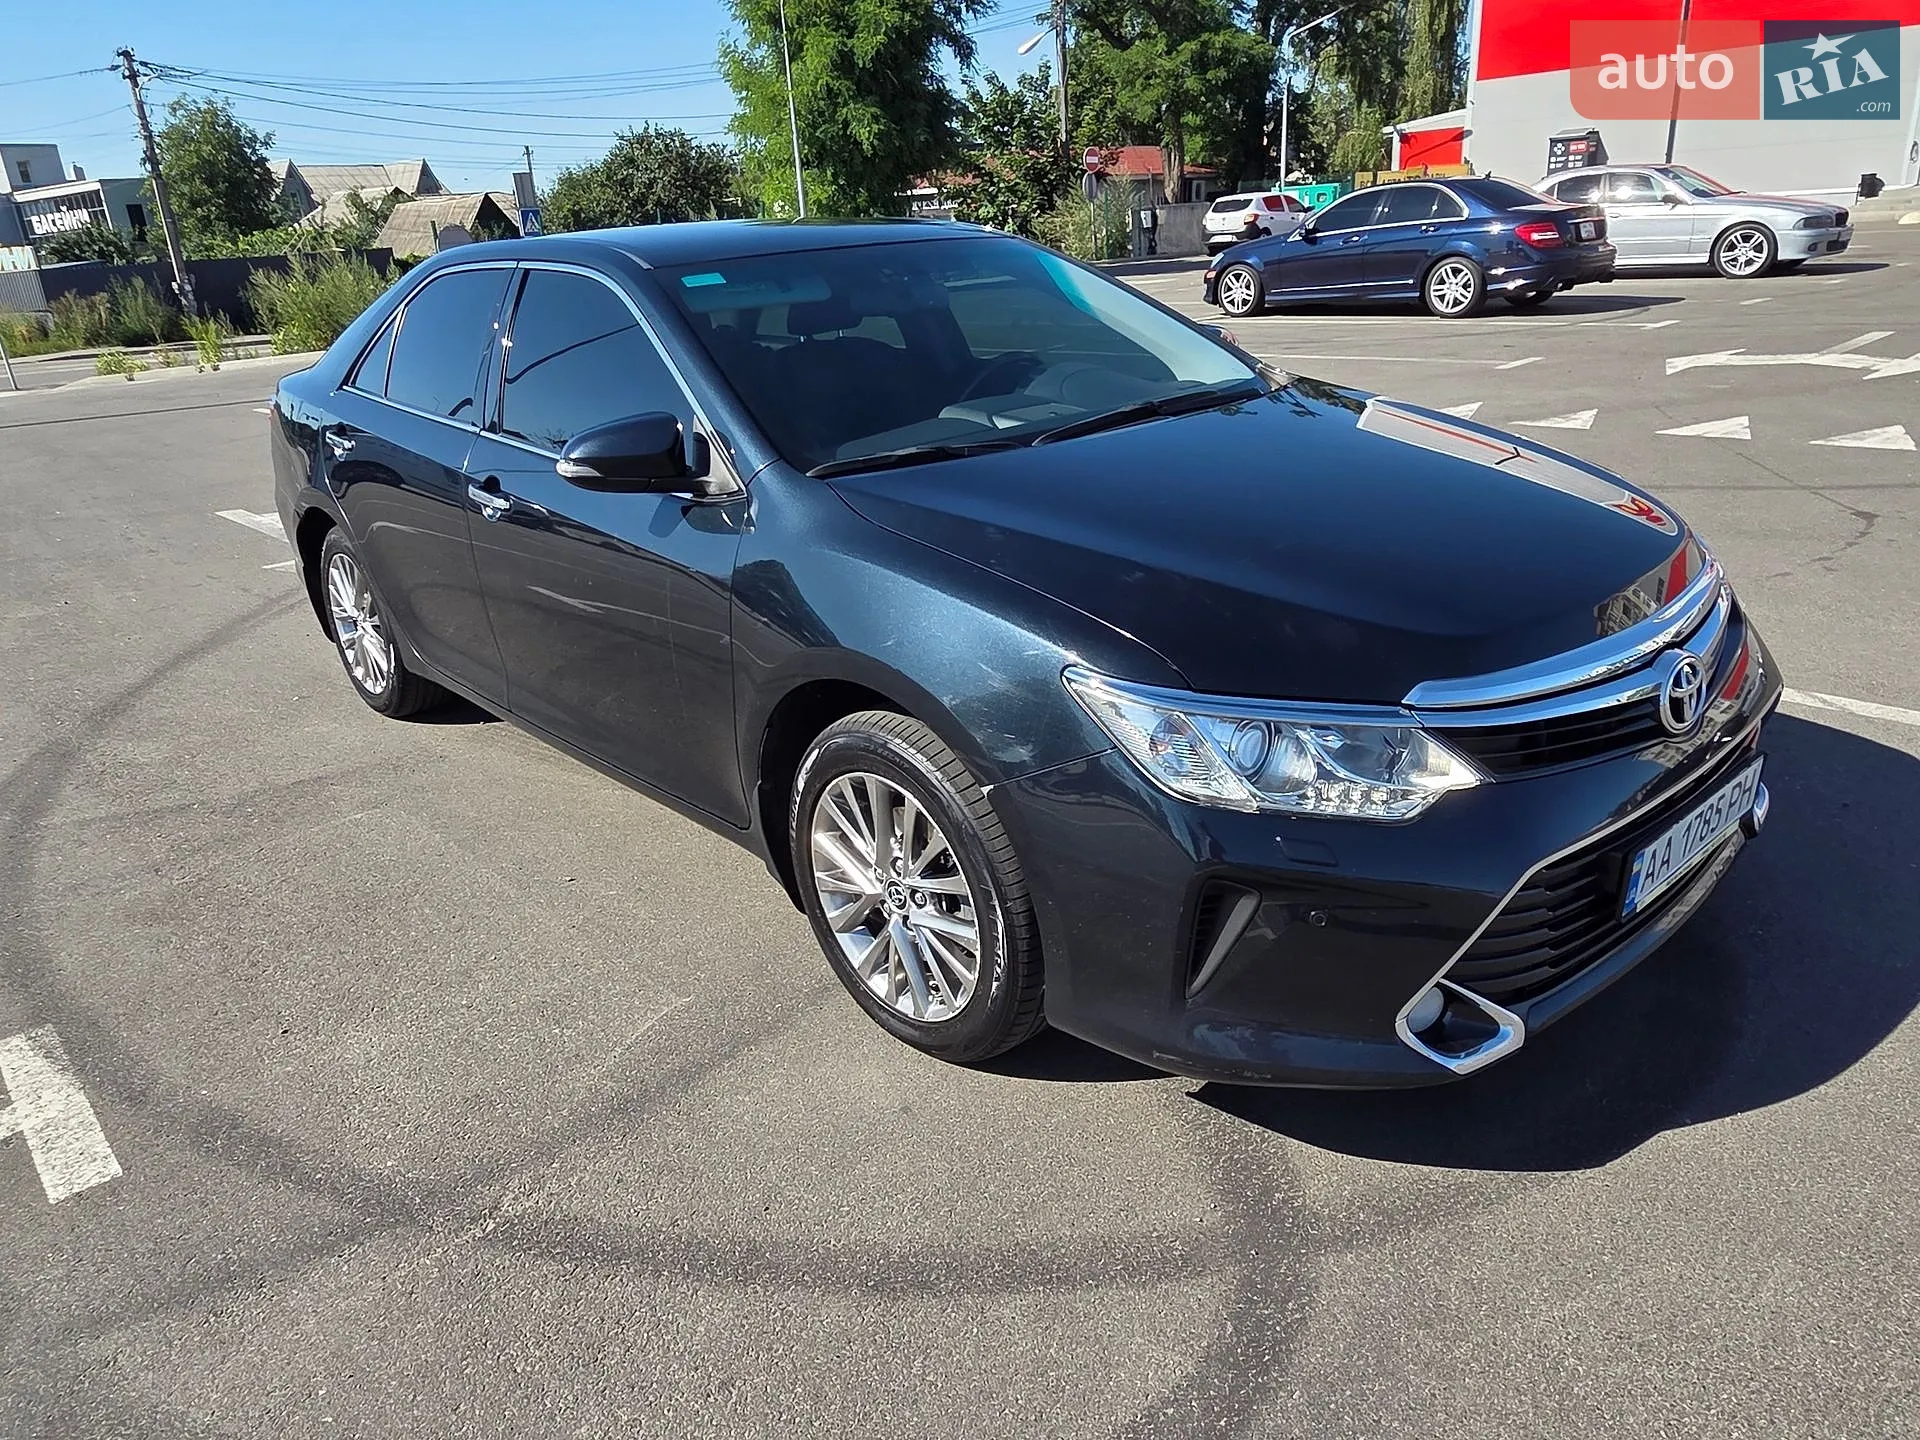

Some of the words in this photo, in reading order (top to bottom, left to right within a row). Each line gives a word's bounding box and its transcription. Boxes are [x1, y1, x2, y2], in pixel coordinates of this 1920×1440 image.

[1640, 835, 1672, 893] AA
[1682, 792, 1726, 858] 1785
[1725, 768, 1757, 823] PH
